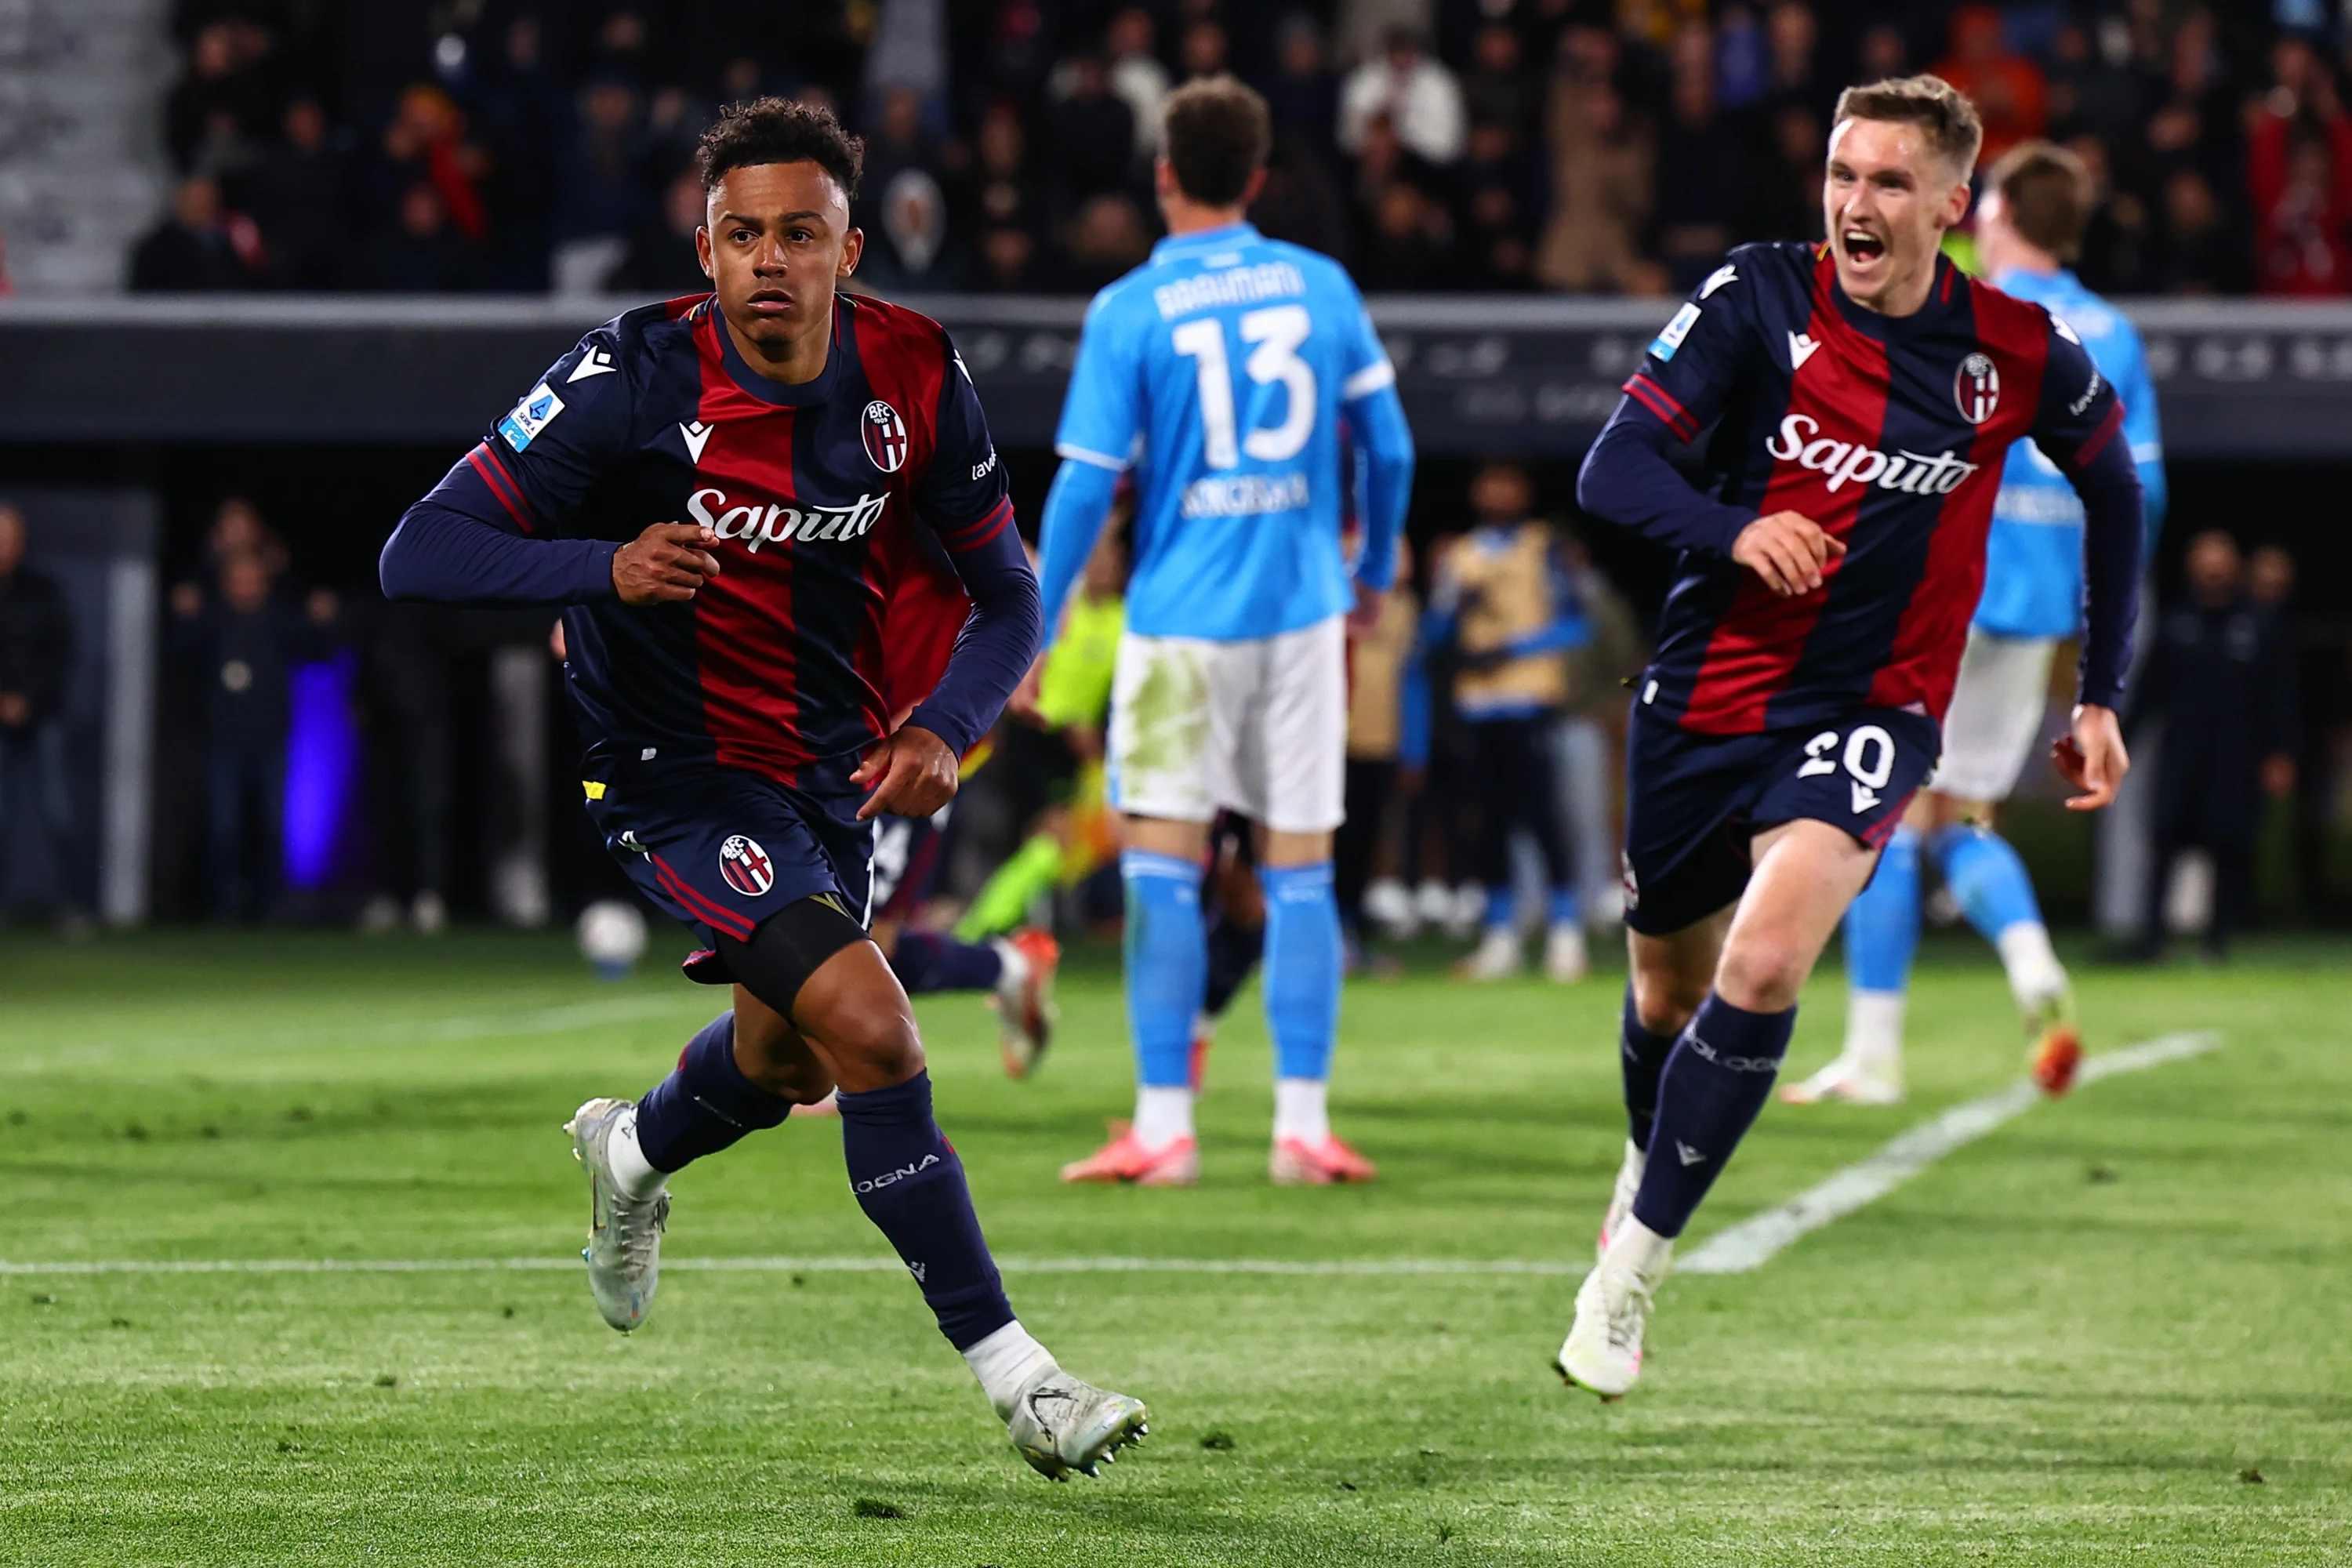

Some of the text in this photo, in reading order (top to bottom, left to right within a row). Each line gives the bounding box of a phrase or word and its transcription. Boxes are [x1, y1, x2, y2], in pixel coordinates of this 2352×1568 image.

[868, 403, 891, 419] BFC
[1171, 303, 1318, 470] 13
[1766, 413, 1980, 494] Saputo
[673, 488, 891, 554] Saputo
[1795, 724, 1896, 789] 20
[722, 837, 745, 859] BFC
